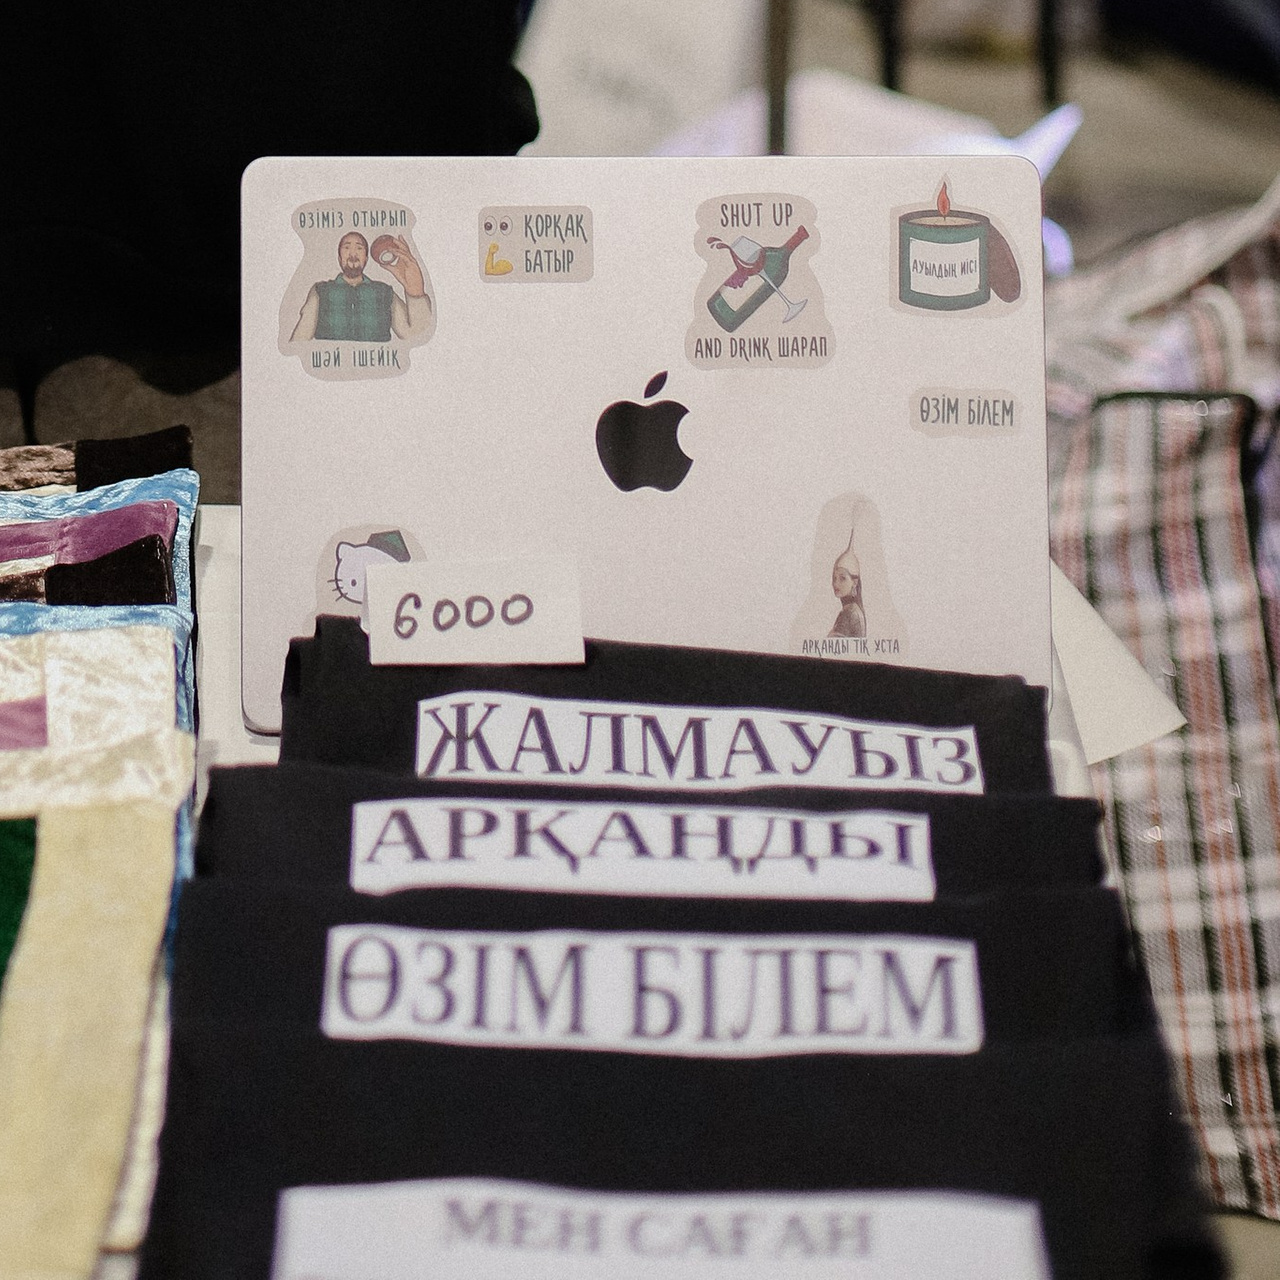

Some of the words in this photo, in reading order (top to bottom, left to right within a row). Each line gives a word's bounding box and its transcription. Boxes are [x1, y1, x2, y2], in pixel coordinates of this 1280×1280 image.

[352, 208, 407, 229] ОТЫРЫП
[720, 202, 763, 227] SHUT
[773, 202, 794, 227] UP
[524, 248, 575, 274] БАТЫР
[311, 348, 341, 370] ШӘЙ
[694, 337, 722, 359] AND
[729, 336, 773, 362] DRINK
[777, 335, 828, 358] ШАРАП
[919, 394, 959, 424] ӨЗІМ
[968, 395, 1015, 427] БІЛЕМ
[393, 592, 535, 639] 6000
[424, 702, 977, 786] ЖАЛМАУЫЗ
[336, 933, 589, 1037] ӨЗІМ
[627, 938, 958, 1041] БІЛЕМ
[443, 1197, 603, 1255] МЕН
